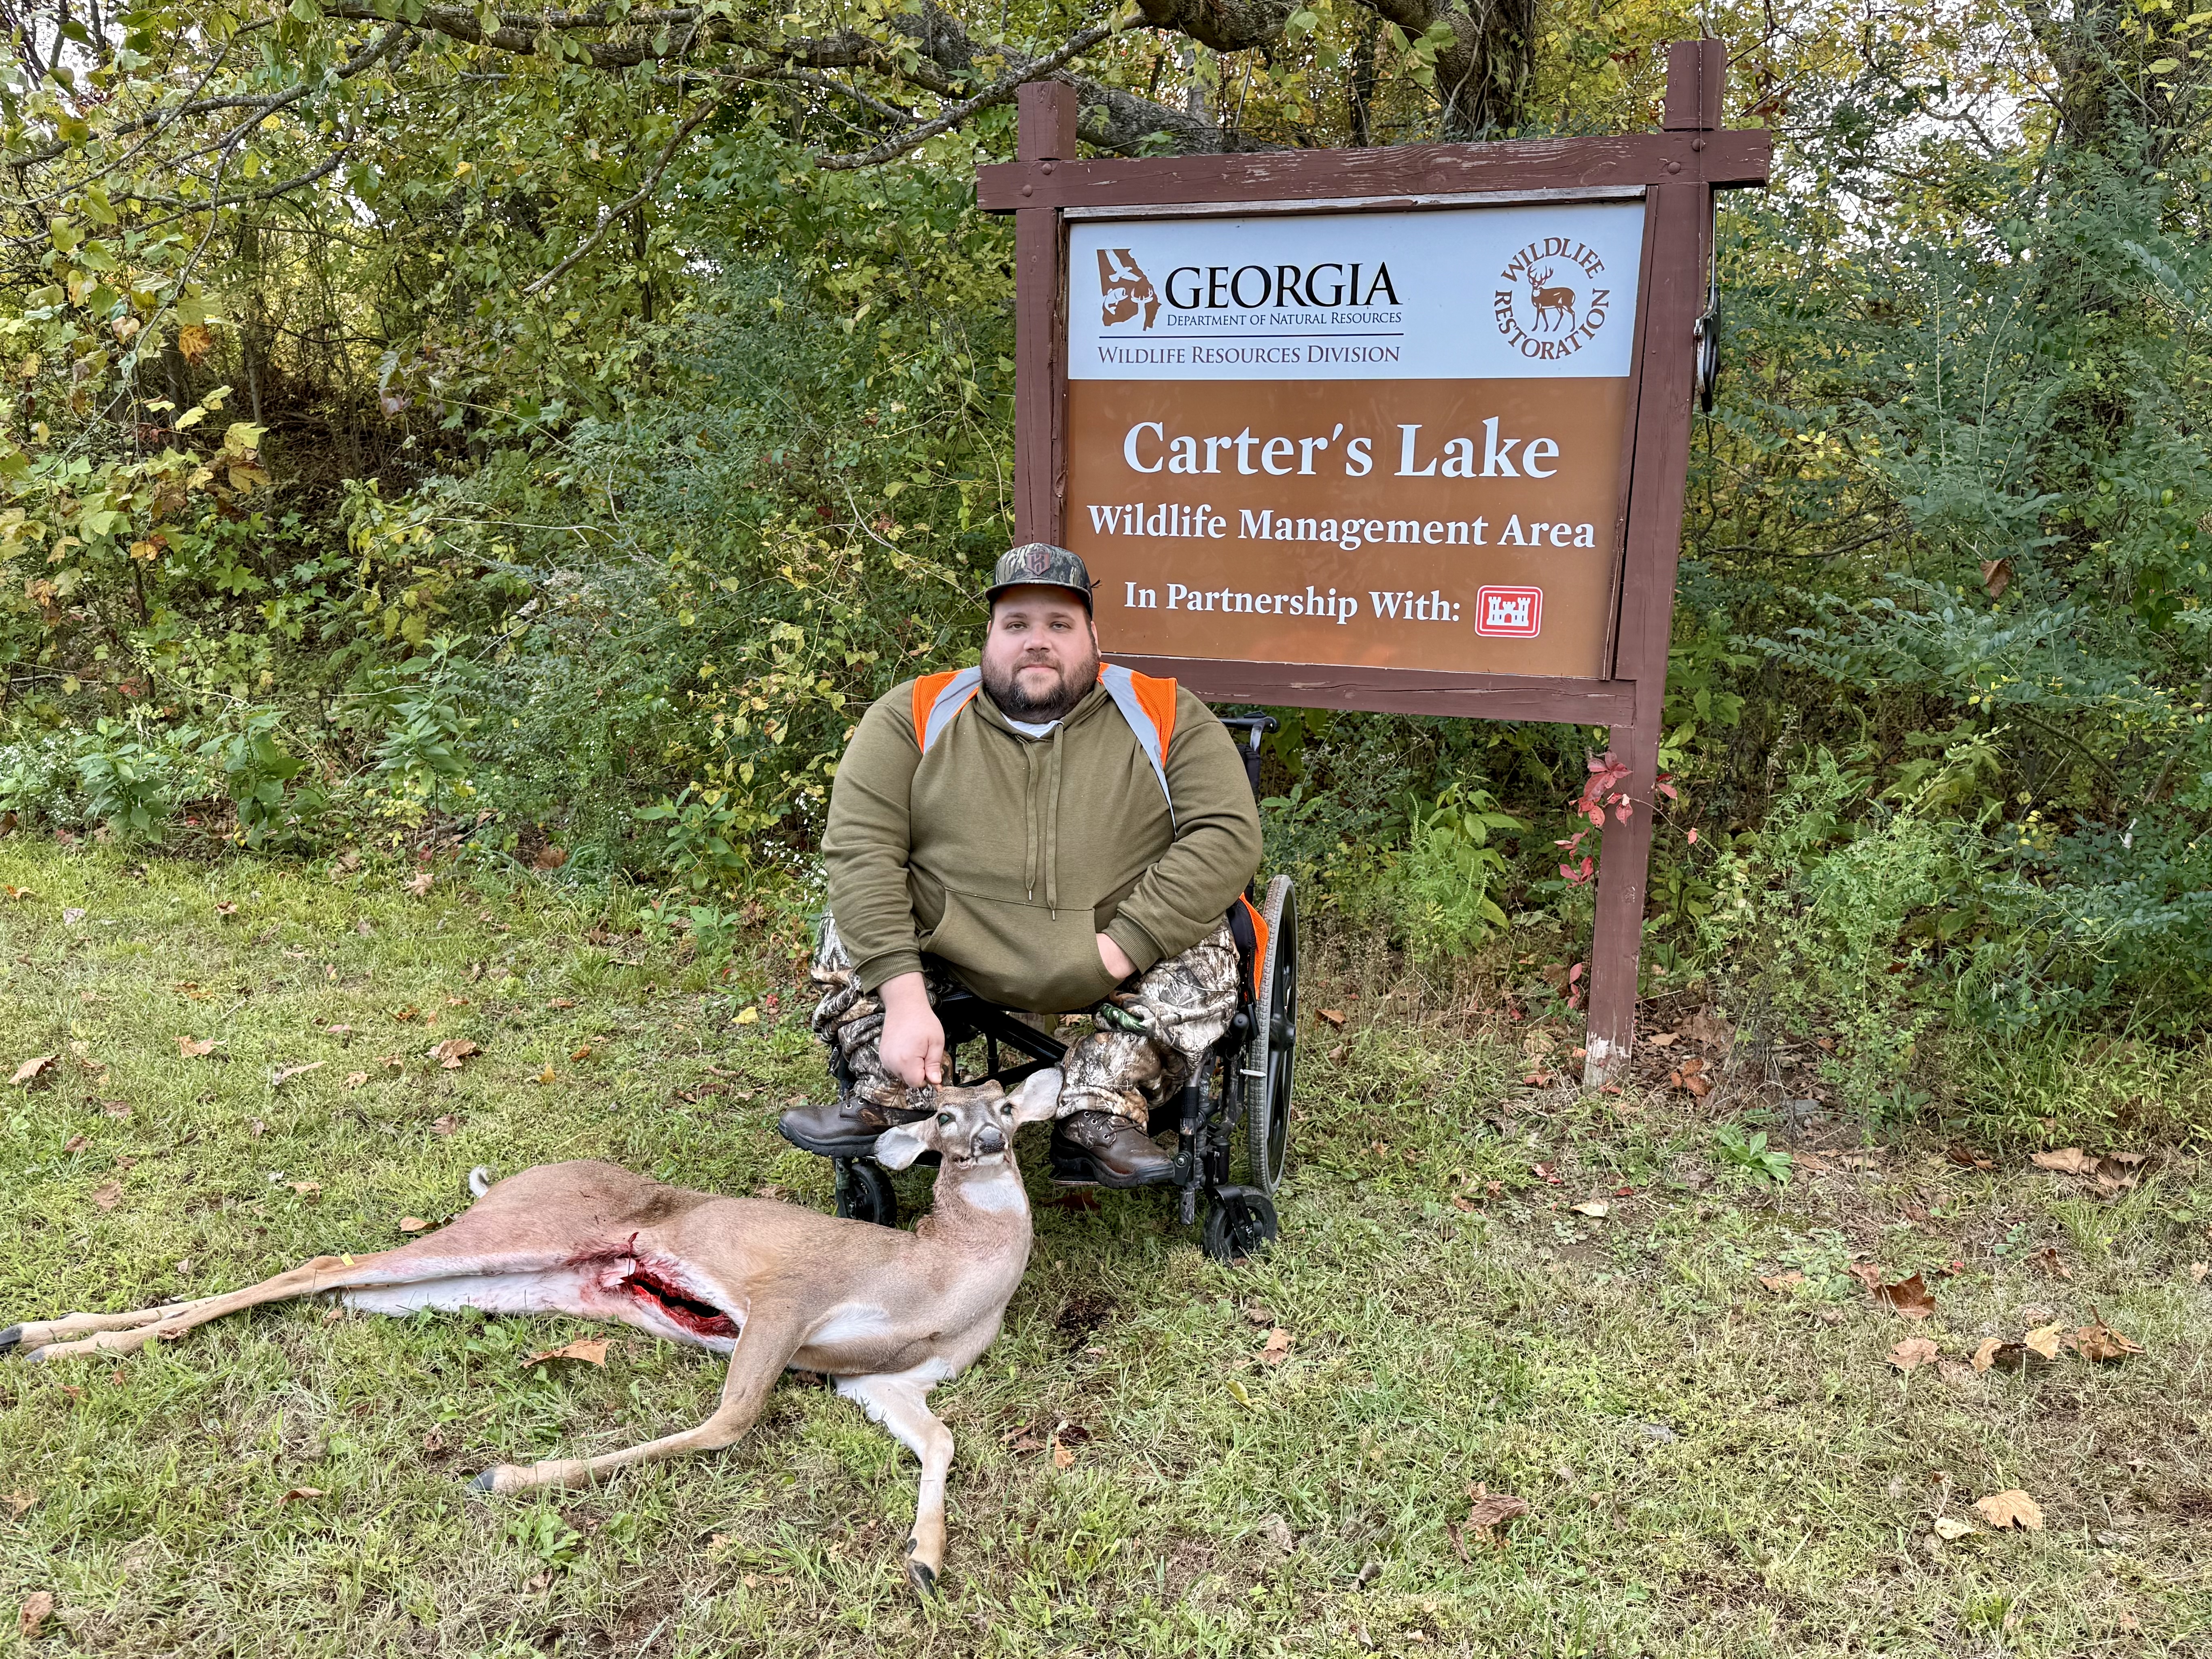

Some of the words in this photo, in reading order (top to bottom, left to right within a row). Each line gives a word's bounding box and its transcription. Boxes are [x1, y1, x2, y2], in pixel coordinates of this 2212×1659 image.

[1501, 237, 1605, 282] WILDLIFE
[1165, 262, 1403, 309] GEORGIA
[1167, 314, 1246, 326] DEPARTMENT
[1270, 313, 1327, 325] NATURAL
[1331, 312, 1401, 324] RESOURCES
[1494, 288, 1610, 360] RESTORATION
[1098, 346, 1185, 363] WILDLIFE
[1192, 346, 1300, 363] RESOURCES
[1307, 345, 1401, 362] DIVISION
[1124, 422, 1373, 477] Carter's
[1394, 416, 1559, 478] Lake
[1087, 503, 1226, 538] Wildlife
[1238, 509, 1488, 551] Management
[1497, 514, 1595, 548] Area
[1124, 582, 1157, 608] In
[1166, 583, 1358, 625] Partnership
[1368, 590, 1460, 621] With:
